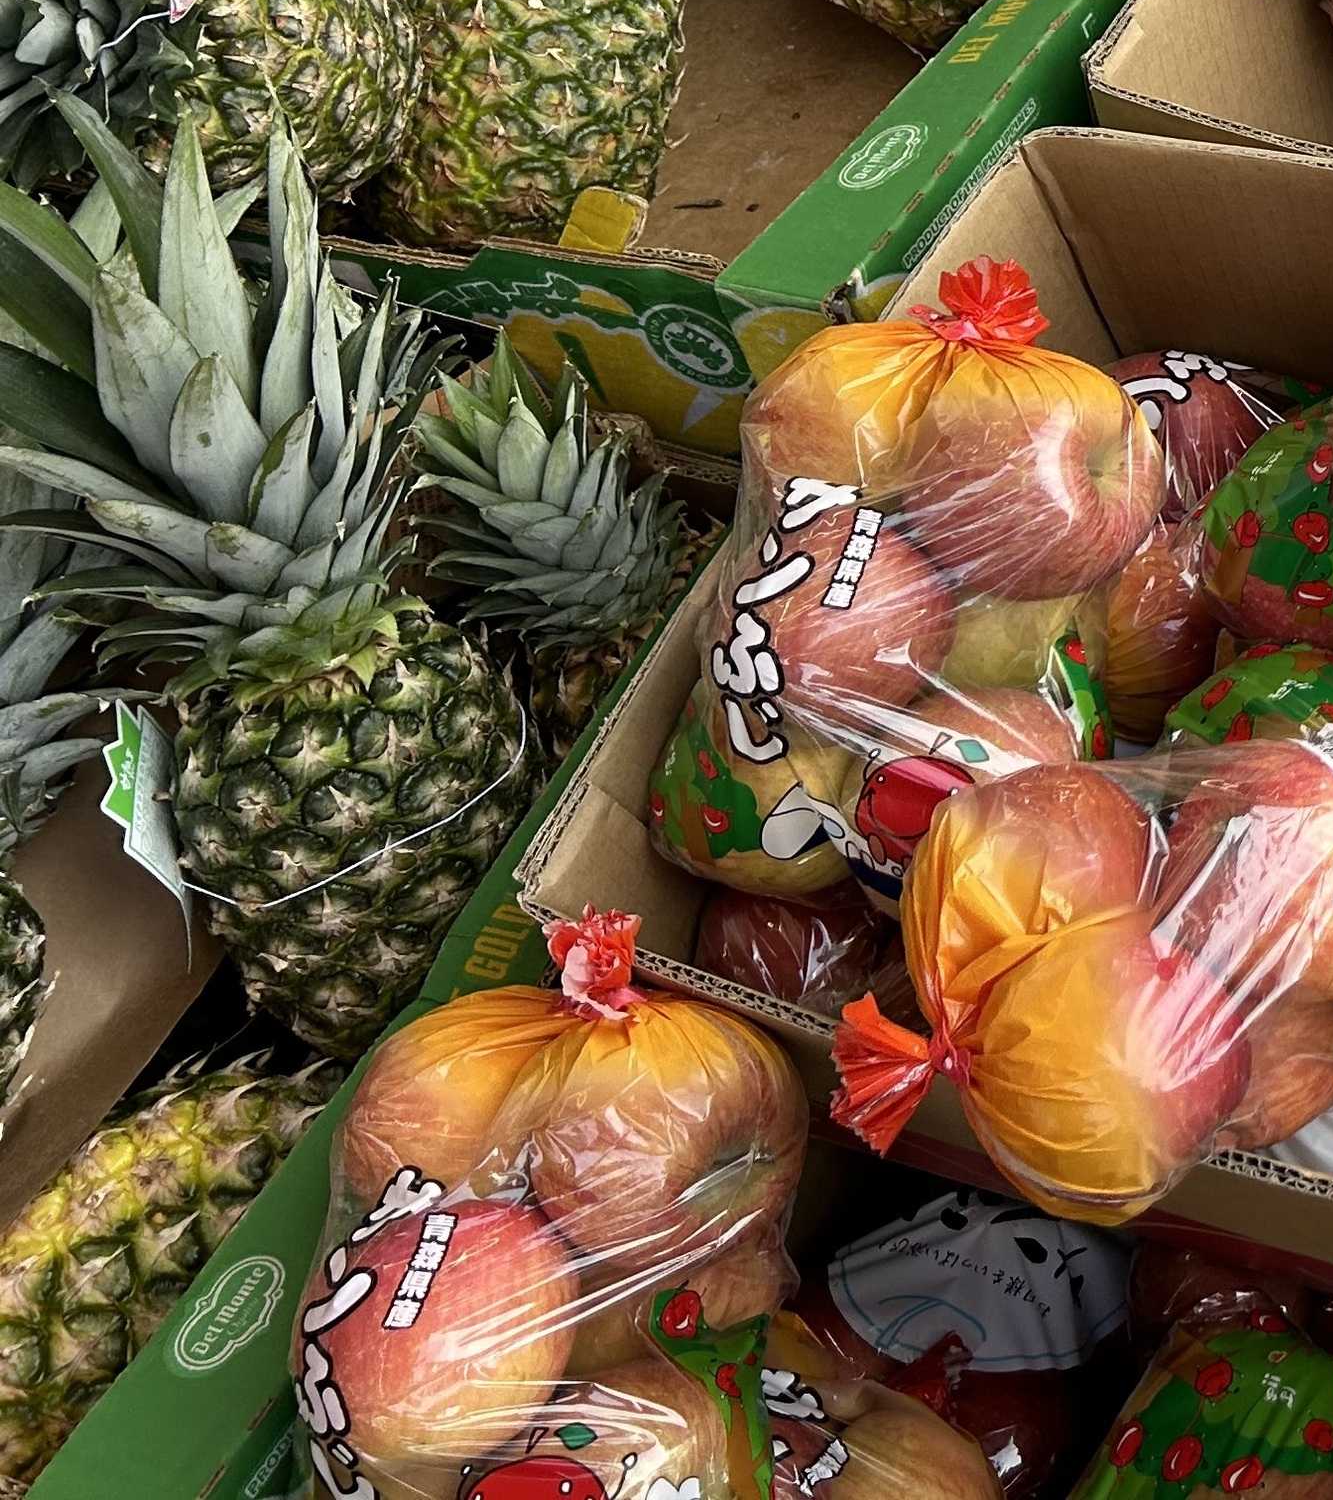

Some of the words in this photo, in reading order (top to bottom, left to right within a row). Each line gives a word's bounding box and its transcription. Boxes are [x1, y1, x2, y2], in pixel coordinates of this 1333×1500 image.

[902, 203, 954, 270] PRODUCT
[821, 505, 885, 611] 青森県産
[711, 475, 862, 764] サンふじ
[190, 1324, 224, 1355] Del
[214, 1266, 267, 1324] Monte
[381, 1211, 460, 1330] 青森県産
